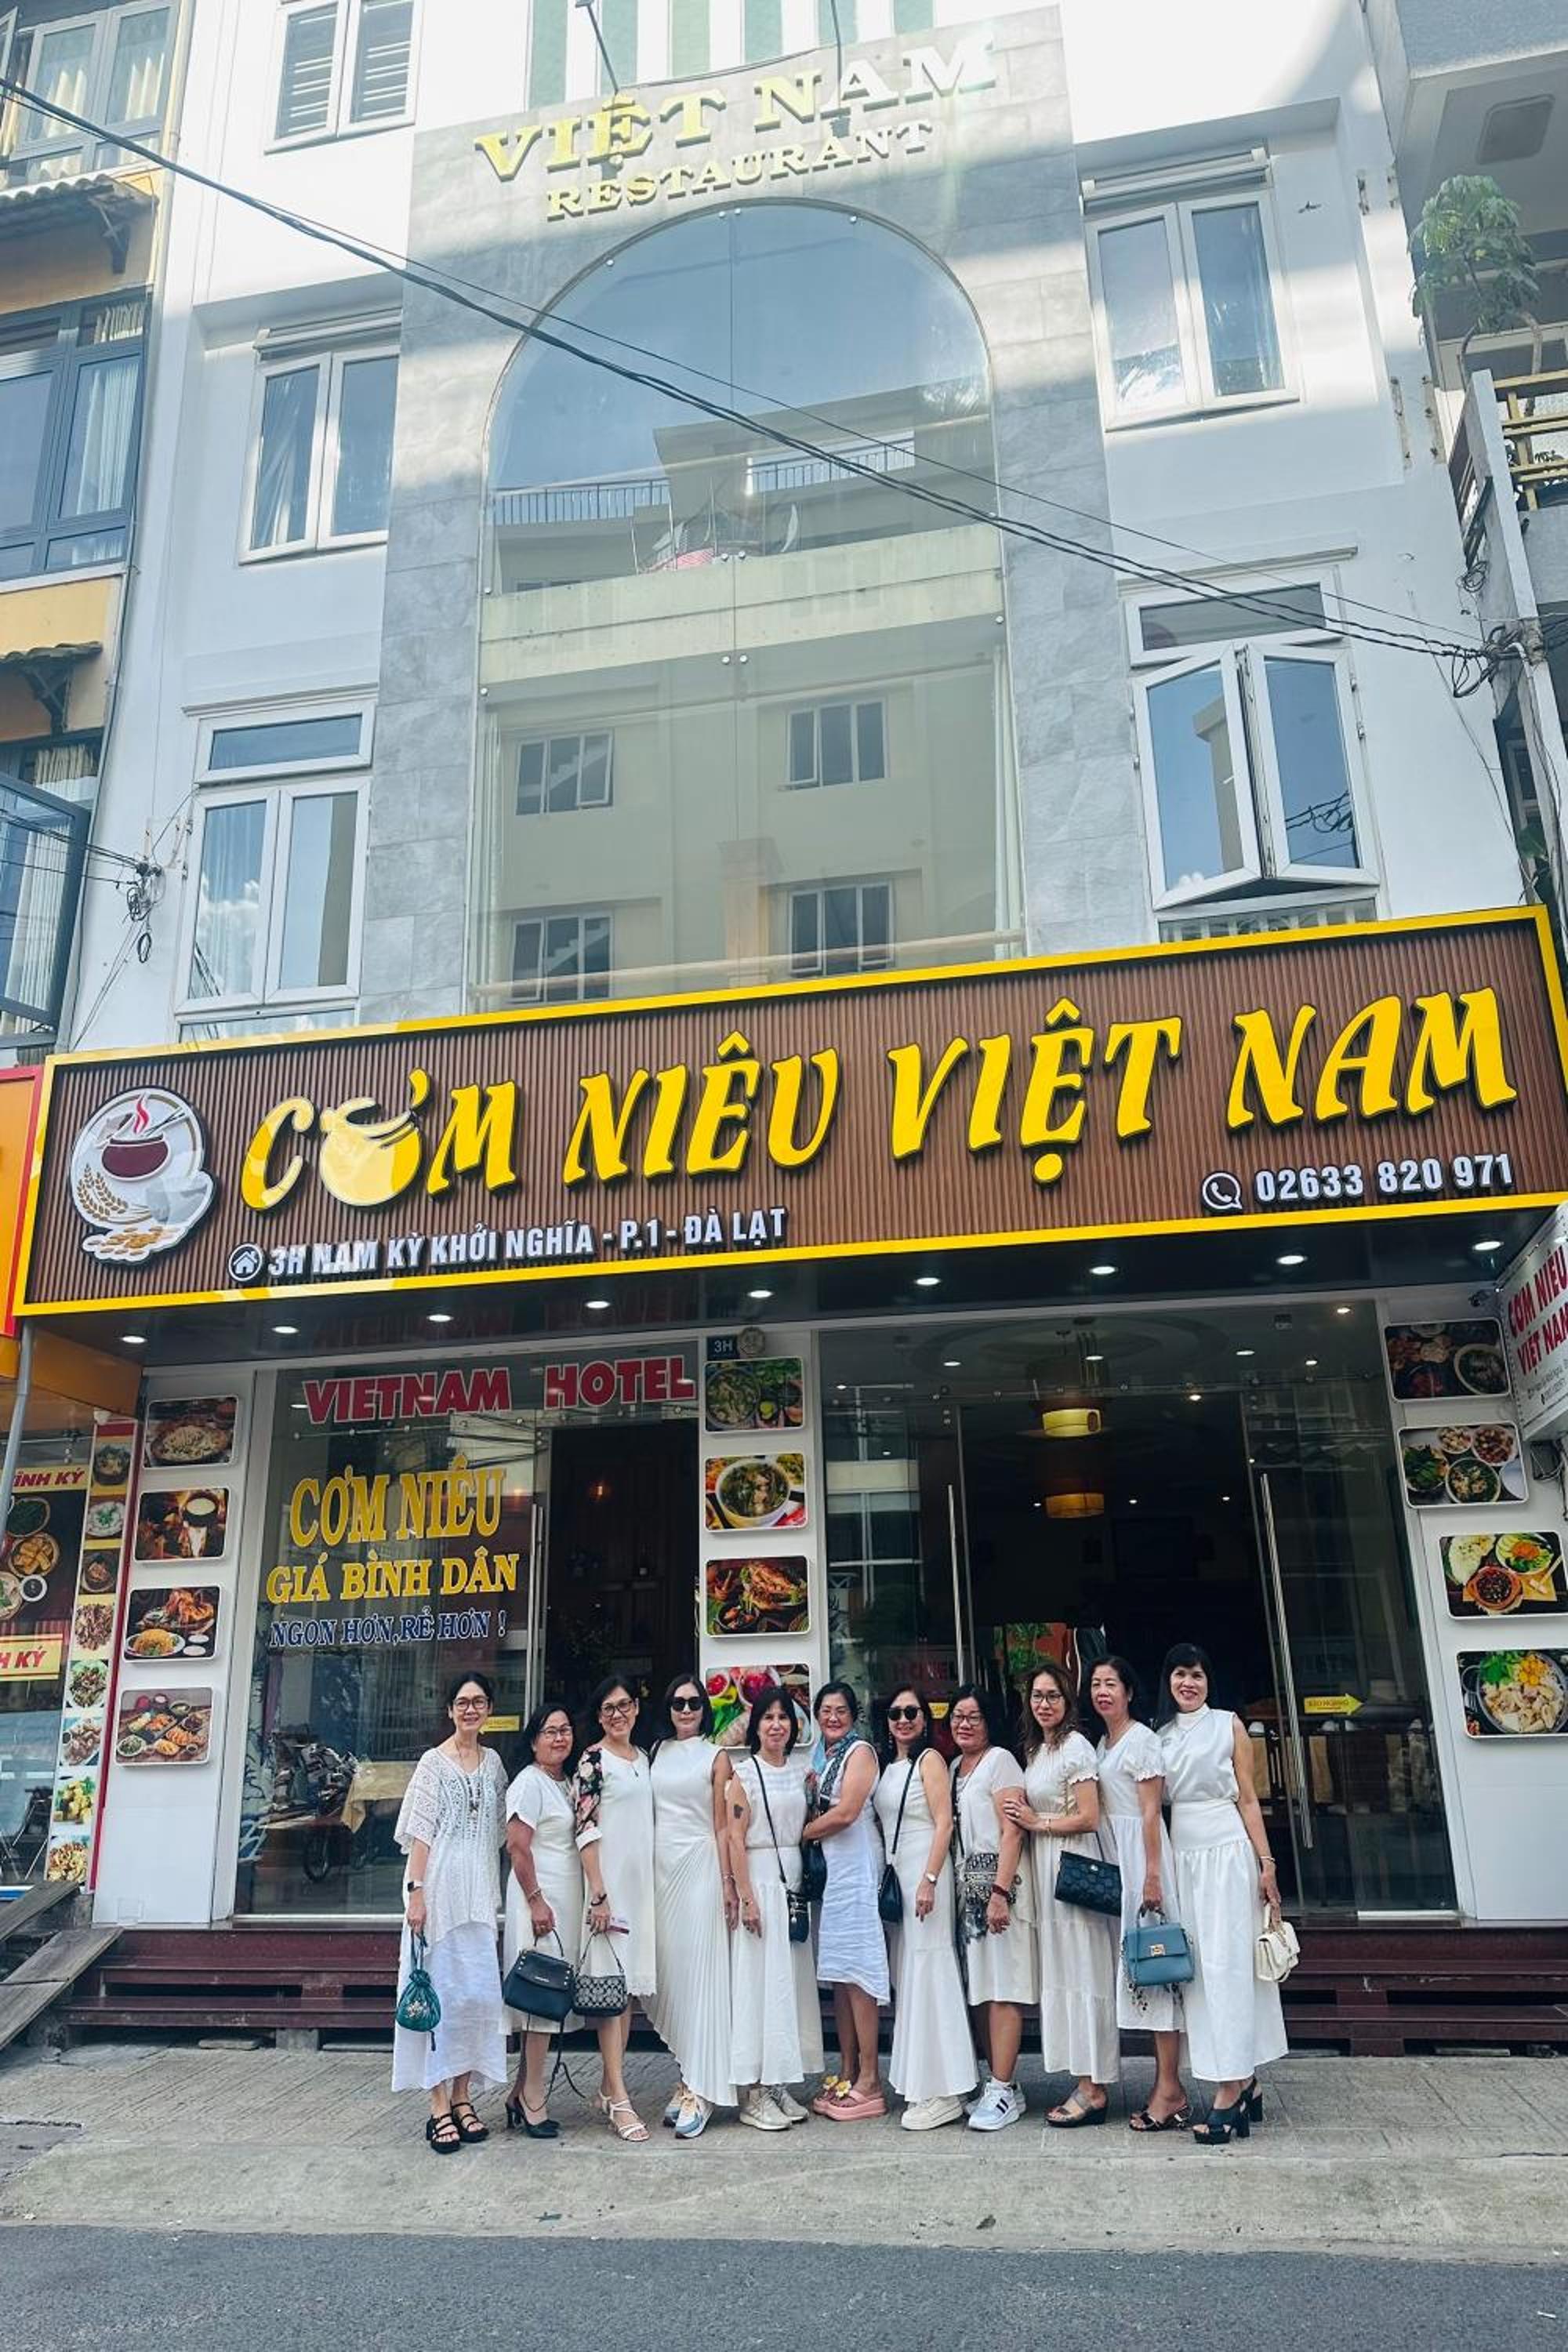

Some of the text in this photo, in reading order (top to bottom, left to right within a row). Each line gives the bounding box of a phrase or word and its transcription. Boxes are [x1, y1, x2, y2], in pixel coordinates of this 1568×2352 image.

[474, 34, 996, 183] VIỆT NAM
[546, 118, 934, 222] RESTAURANT
[563, 1030, 839, 1185] NIÊU
[887, 996, 1182, 1185] VIỆT
[1226, 986, 1517, 1130] NAM
[1256, 1152, 1512, 1203] 02633 820 971
[268, 1243, 307, 1276] 3H
[313, 1240, 379, 1275] NAM
[387, 1231, 424, 1269] KỲ
[430, 1222, 496, 1266] KHỞI
[506, 1219, 593, 1259] NGHĨA
[733, 1207, 786, 1247] LẠT
[714, 1339, 734, 1354] 3H
[303, 1355, 696, 1425] VIETNAM HOTEL
[55, 1467, 85, 1485] KÝ
[289, 1464, 390, 1548] CƠM
[266, 1544, 520, 1605] GIÁ BÌNH DÂN
[14, 1646, 48, 1668] KÝ
[270, 1618, 337, 1647] NGON
